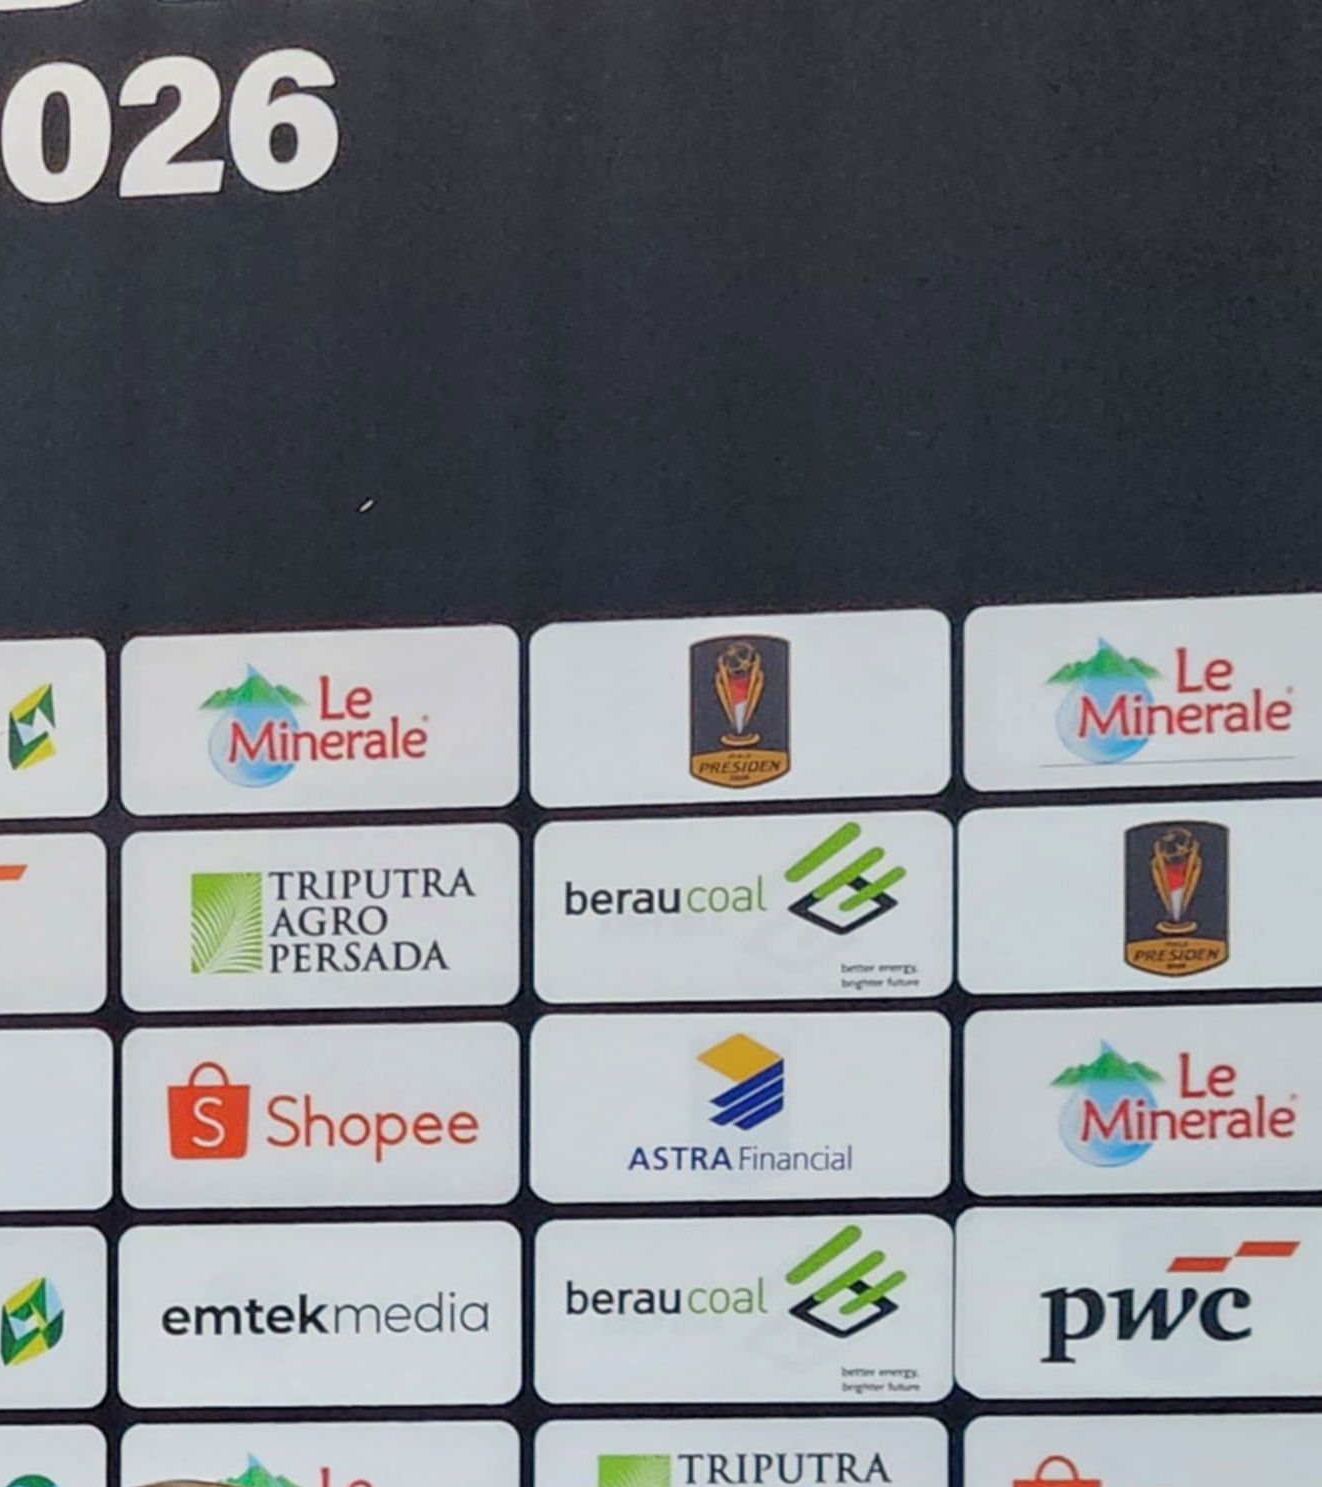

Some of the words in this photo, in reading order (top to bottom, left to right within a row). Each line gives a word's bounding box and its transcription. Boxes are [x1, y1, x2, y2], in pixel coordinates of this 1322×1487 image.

[1176, 648, 1234, 694] Le
[320, 676, 373, 721] Le
[1077, 689, 1293, 739] Minerale
[227, 715, 428, 764] Minerale
[269, 867, 475, 902] TRIPUTRA
[269, 904, 388, 938] AGRO
[269, 941, 450, 975] PERSADA
[1179, 1053, 1236, 1100] Le
[266, 1096, 479, 1163] Shopee
[1080, 1096, 1296, 1144] Minerale
[628, 1146, 733, 1172] ASTRA
[739, 1144, 852, 1172] Financial
[162, 1292, 489, 1338] emtekmedia
[1040, 1286, 1253, 1363] pwc
[678, 1452, 891, 1486] TRIPUTRA
